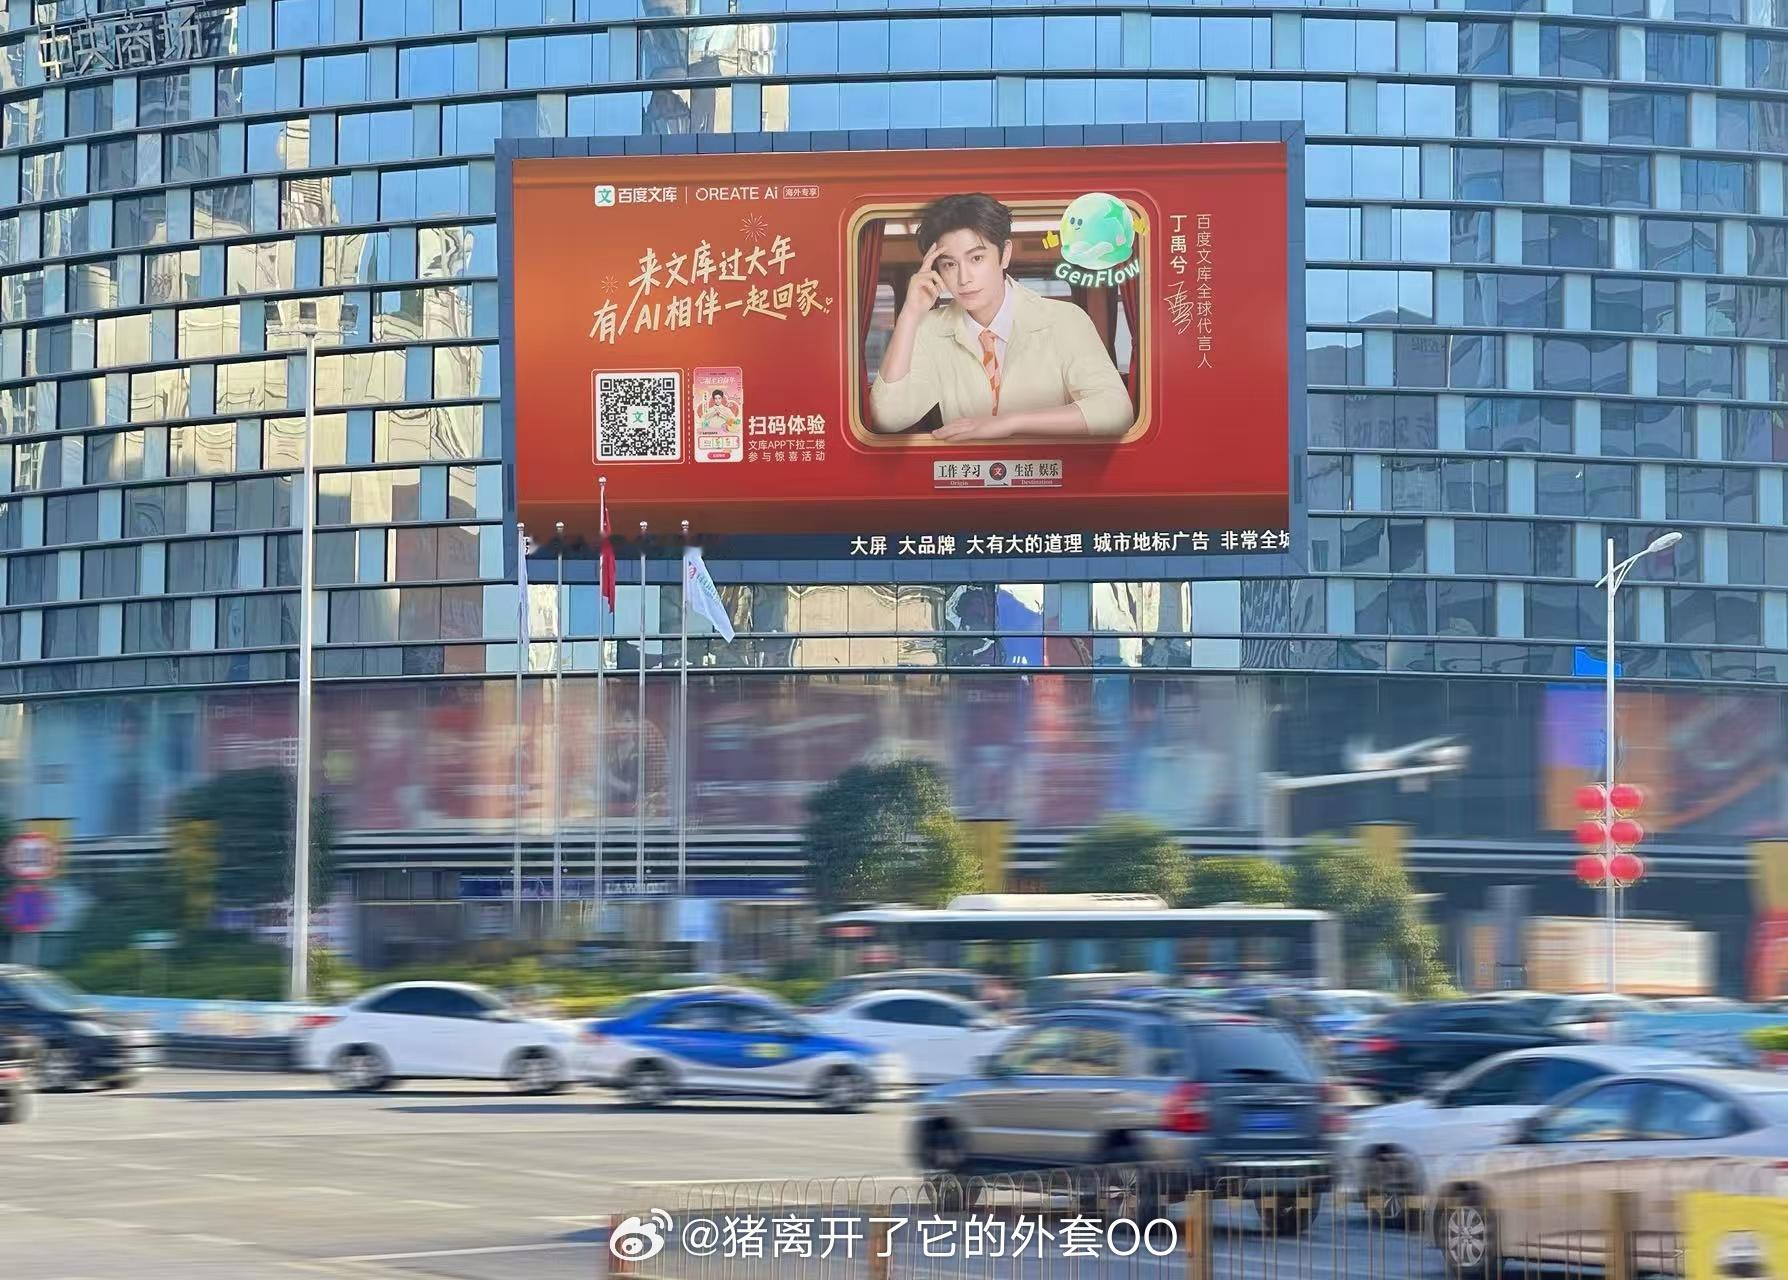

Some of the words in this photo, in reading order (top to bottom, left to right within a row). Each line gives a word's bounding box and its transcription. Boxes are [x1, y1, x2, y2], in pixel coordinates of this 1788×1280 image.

[39, 7, 204, 79] 中央商场
[617, 186, 678, 203] 百度文库
[785, 187, 818, 197] 海外专享
[1169, 214, 1188, 275] 丁禹兮
[628, 234, 796, 296] 来文库过大年
[1055, 259, 1140, 286] GenFlow
[1196, 213, 1213, 369] 百度文库全球代言人
[589, 277, 825, 344] 有AI相伴一起回家
[748, 415, 826, 436] 扫码体验
[748, 439, 826, 451] 文库APP下拉二楼
[748, 451, 826, 462] 参与惊喜活动
[938, 464, 958, 478] 工作
[961, 463, 981, 478] 学习
[1014, 463, 1034, 478] 生活
[1038, 462, 1059, 476] 娱乐
[849, 535, 888, 556] 大屏
[898, 534, 956, 555] 大品牌
[966, 533, 1083, 554] 大有大的道理
[1093, 531, 1210, 552] 城市地标广告
